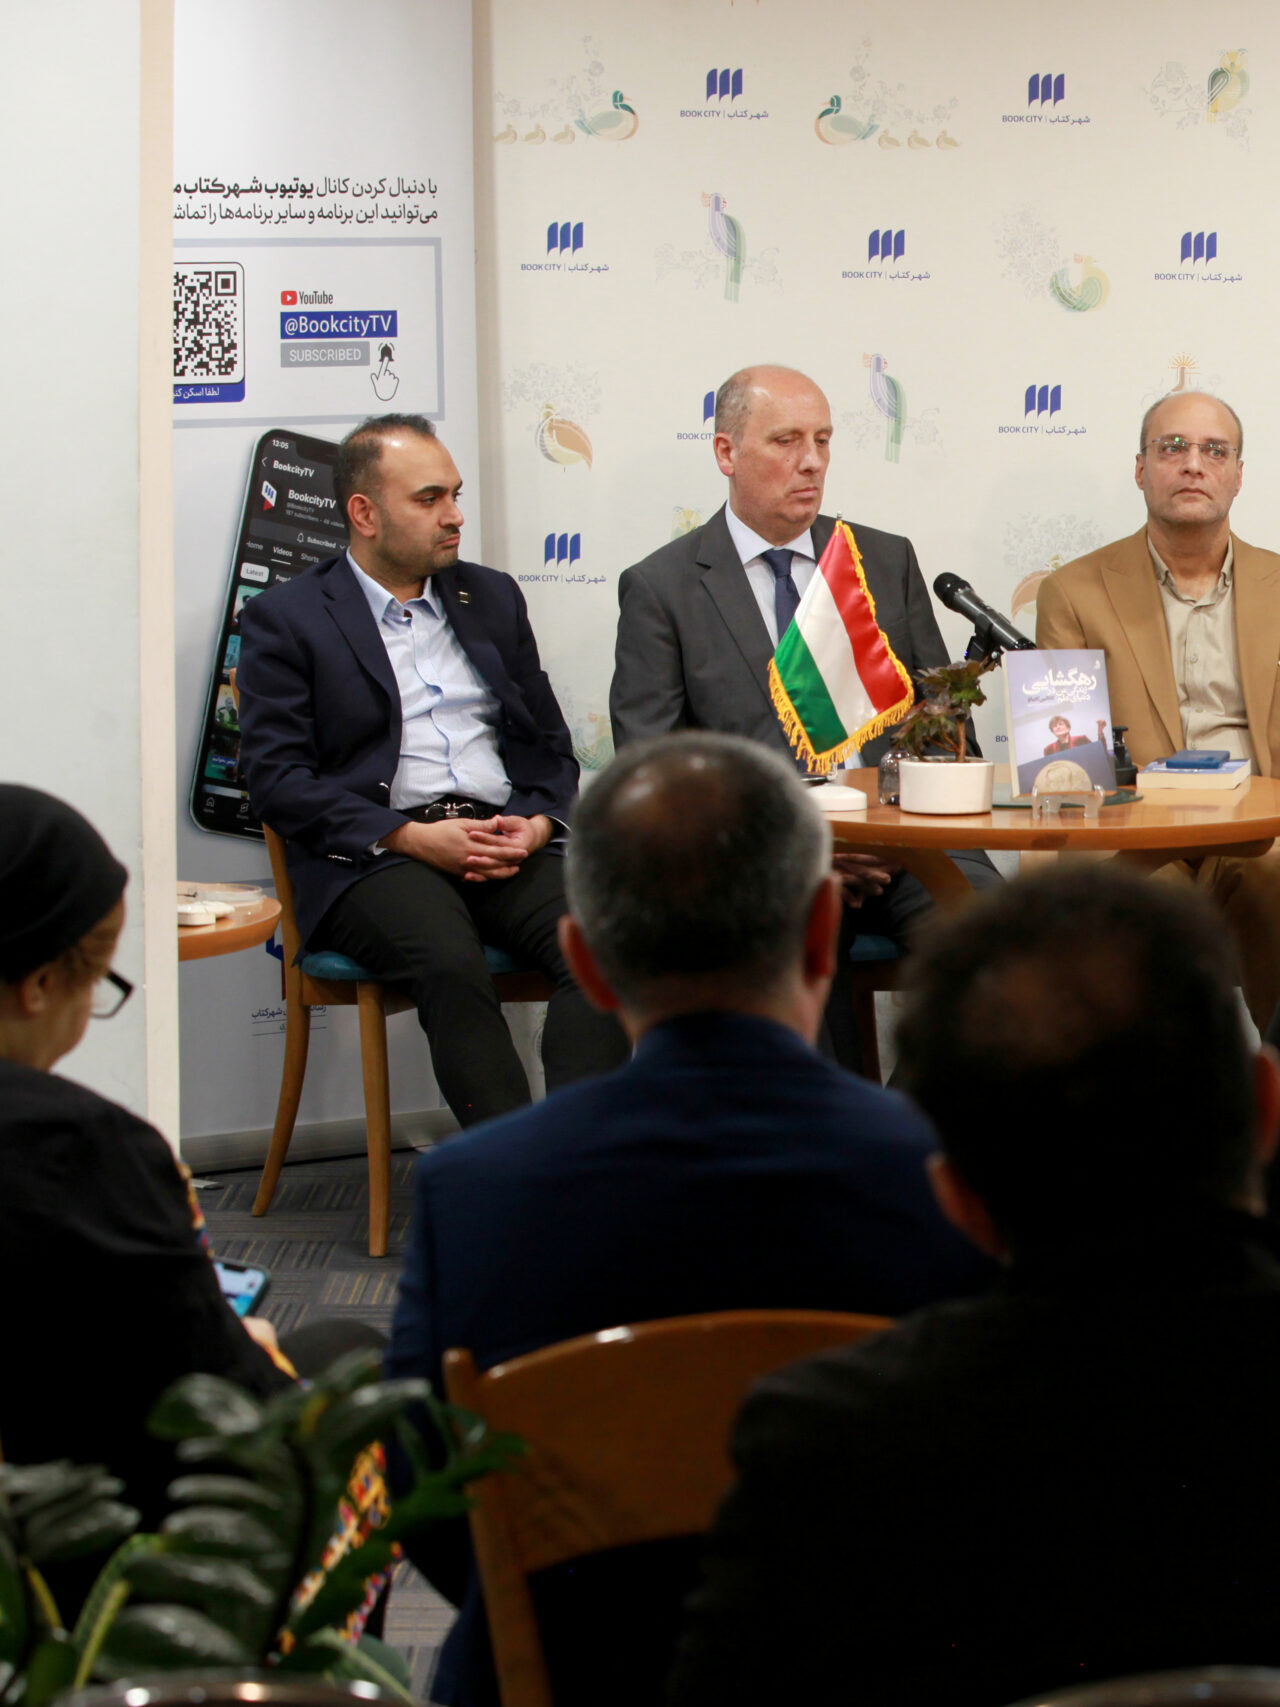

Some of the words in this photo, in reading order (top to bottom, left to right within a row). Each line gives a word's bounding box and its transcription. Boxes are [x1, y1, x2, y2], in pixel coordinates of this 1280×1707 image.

[680, 110, 703, 118] BOOK
[703, 110, 721, 118] CITY
[1002, 115, 1024, 123] BOOK
[1025, 115, 1043, 123] CITY
[264, 177, 314, 200] یوتیوب
[316, 176, 350, 197] کانال
[351, 177, 387, 199] کردن
[388, 176, 427, 198] دنبال
[428, 178, 438, 199] با
[207, 203, 218, 225] را
[273, 203, 308, 225] سایر
[308, 210, 315, 224] و
[316, 203, 353, 224] برنامه
[356, 202, 379, 223] این
[520, 263, 544, 271] BOOK
[544, 263, 562, 271] CITY
[299, 291, 334, 305] YouTube
[284, 314, 392, 336] @BookcityTV
[289, 348, 362, 362] SUBSCRIBED
[204, 387, 220, 397] لطفا
[998, 426, 1020, 434] BOOK
[1021, 426, 1039, 434] CITY
[272, 439, 289, 450] 13:05
[273, 459, 315, 478] BookcityTV
[288, 489, 336, 509] BookcityTV
[273, 546, 293, 557] Videos
[300, 552, 320, 563] Shorts
[246, 568, 264, 577] Latest
[518, 574, 542, 582] BOOK
[541, 574, 559, 582] CITY
